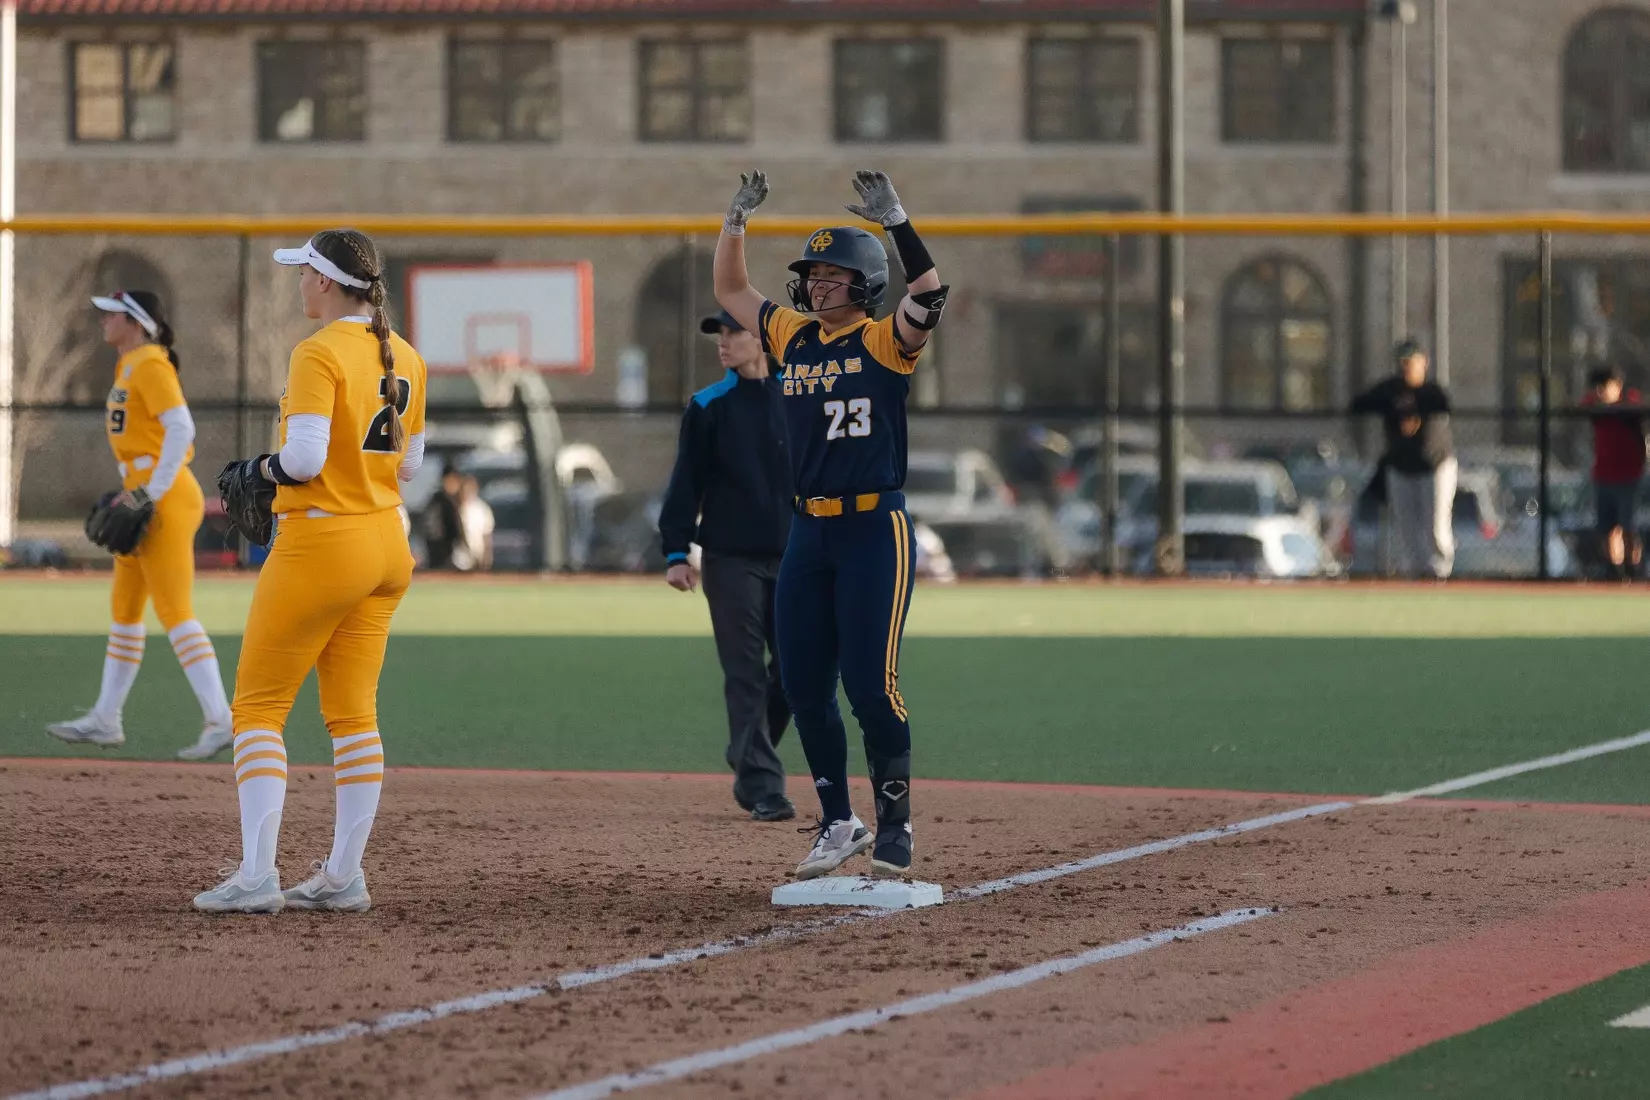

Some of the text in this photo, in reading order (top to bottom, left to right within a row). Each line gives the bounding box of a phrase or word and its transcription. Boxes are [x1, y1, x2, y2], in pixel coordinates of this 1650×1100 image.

[781, 357, 862, 379] ANSAS
[783, 376, 837, 396] CITY
[361, 376, 412, 453] 2
[823, 397, 872, 440] 23
